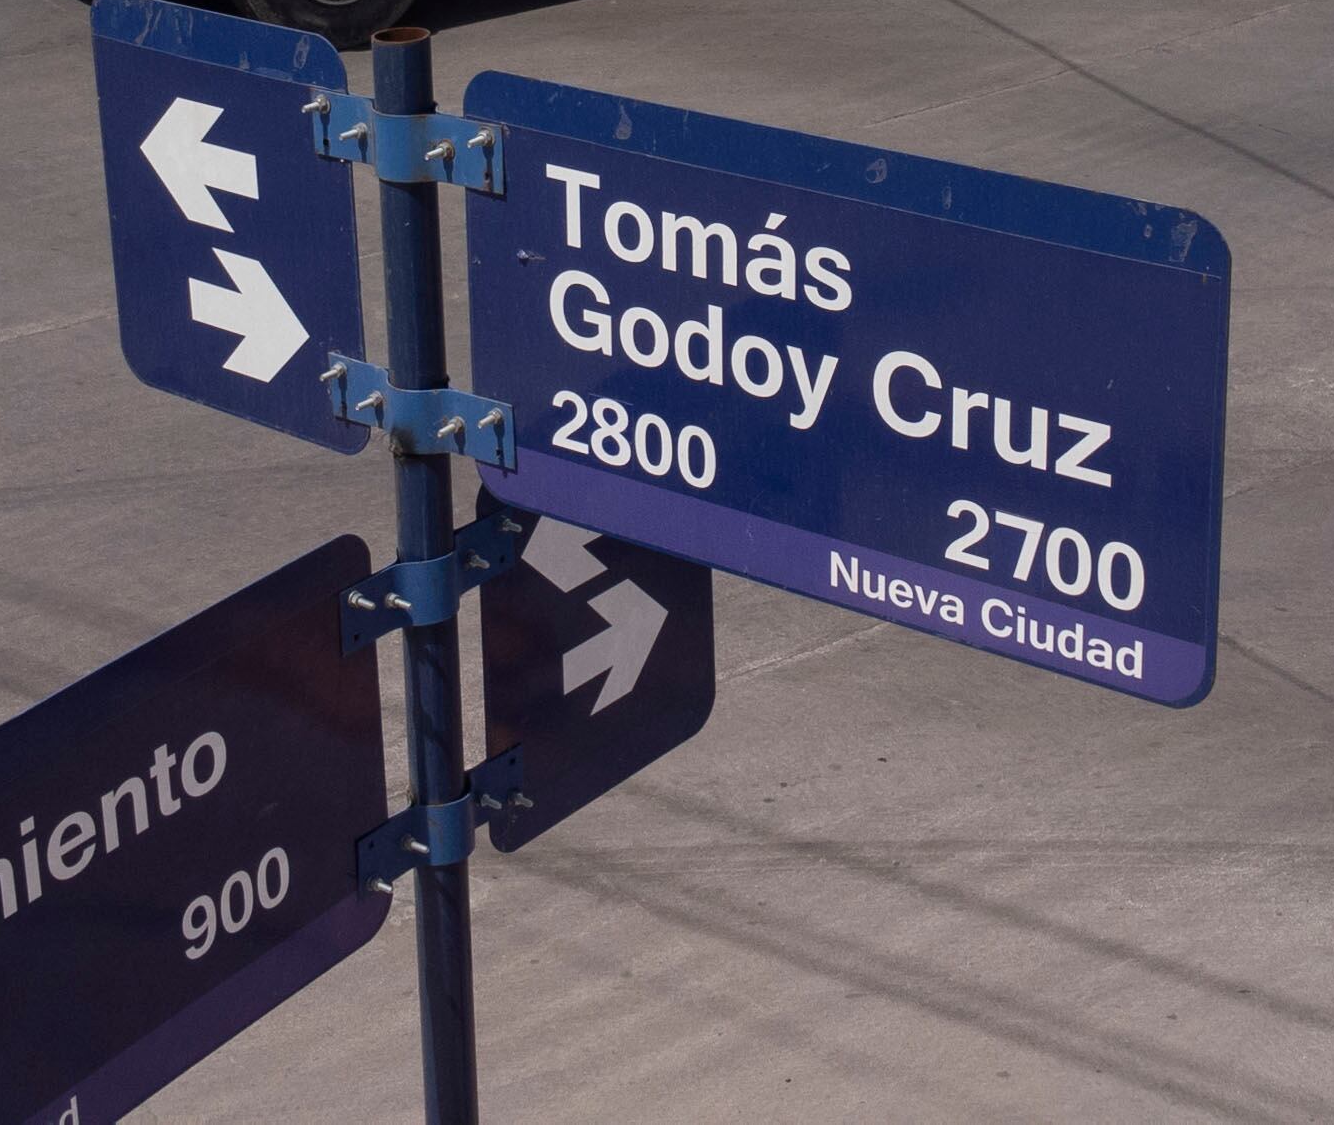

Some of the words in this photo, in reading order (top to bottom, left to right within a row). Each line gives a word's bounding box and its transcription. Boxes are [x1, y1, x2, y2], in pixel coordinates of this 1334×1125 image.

[546, 164, 852, 310] Tomás
[549, 271, 839, 430] Godoy
[872, 351, 1112, 488] Cruz
[552, 391, 717, 489] 2800
[830, 551, 965, 626] Nueva
[981, 599, 1143, 679] Ciudad
[944, 500, 1145, 611] 2700
[182, 848, 290, 960] 900
